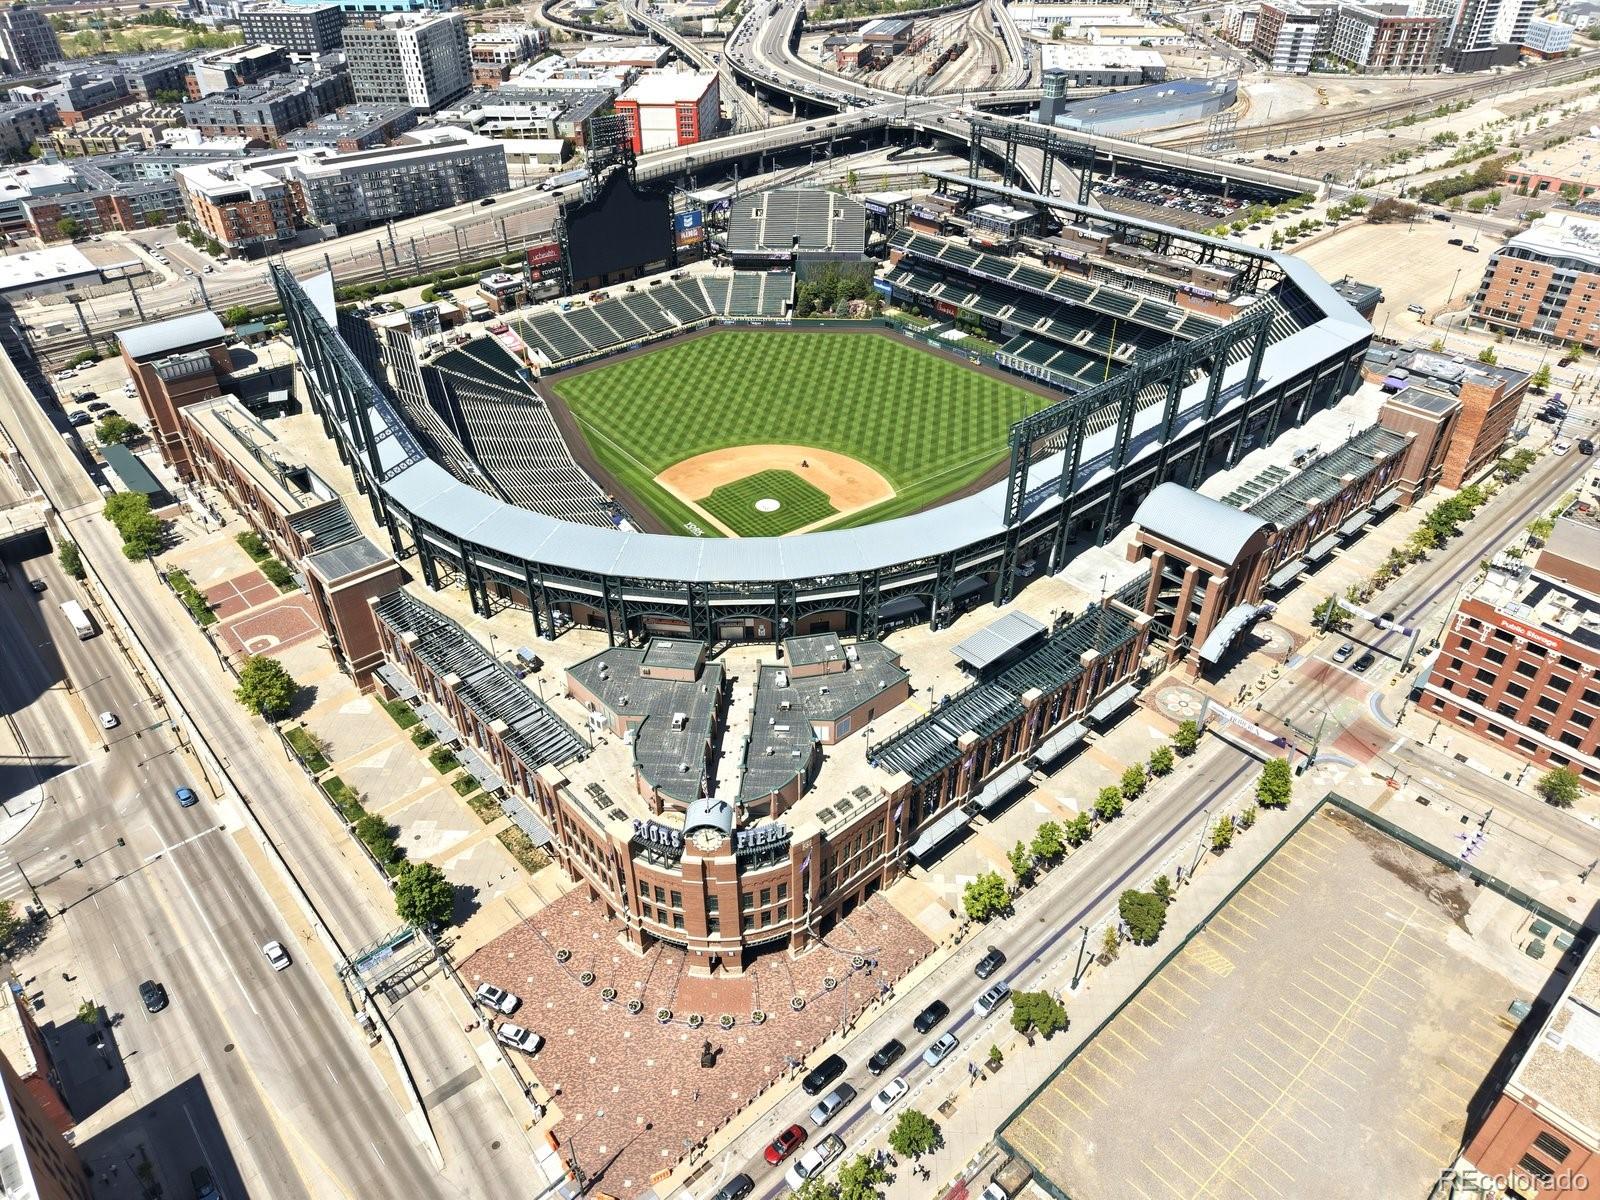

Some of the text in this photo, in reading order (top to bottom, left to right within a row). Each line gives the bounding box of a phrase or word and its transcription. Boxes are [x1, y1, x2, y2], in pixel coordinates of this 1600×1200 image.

[542, 267, 562, 276] TOYOTA
[1501, 620, 1559, 648] Public Storage
[633, 819, 788, 849] COORS FIELD
